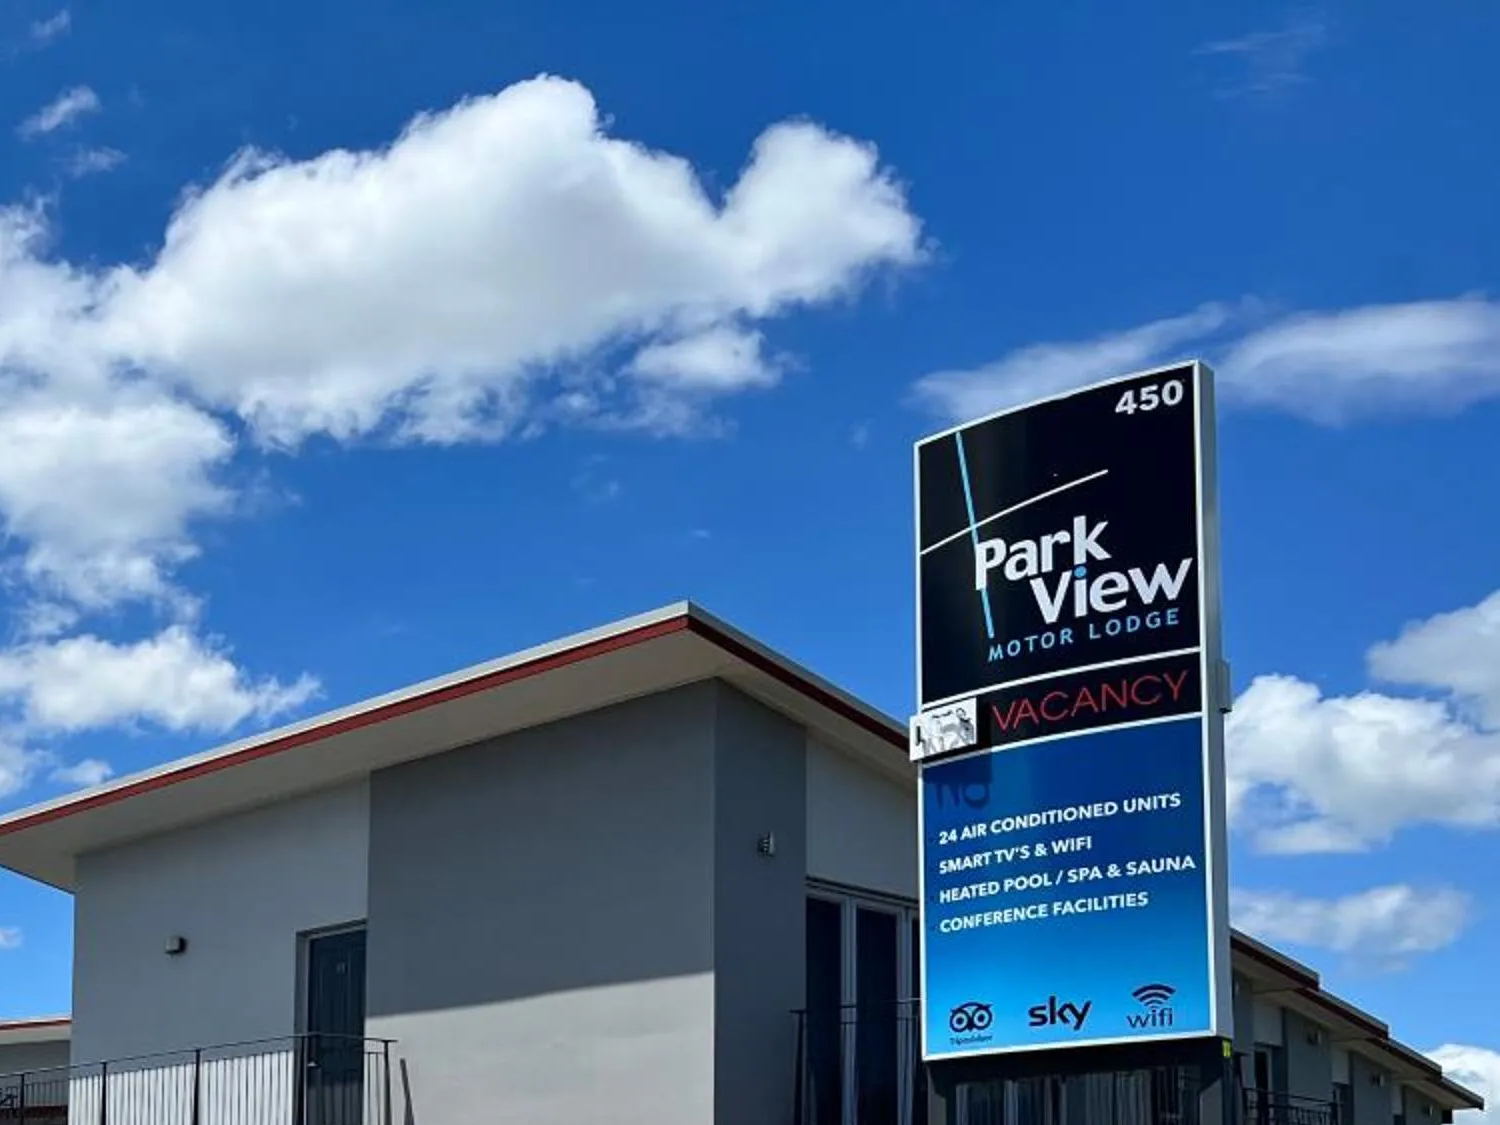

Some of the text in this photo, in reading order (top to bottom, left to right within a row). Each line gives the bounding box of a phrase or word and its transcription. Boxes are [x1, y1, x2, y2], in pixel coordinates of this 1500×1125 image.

[1115, 379, 1184, 414] 450
[975, 515, 1112, 591] Park
[1030, 558, 1193, 624] View
[988, 608, 1180, 662] MOTOR LODGE
[992, 670, 1189, 731] VACANCY
[939, 793, 1181, 845] 24 AIR CONDITIONED UNITS
[939, 836, 1092, 875] SMART TV'S & WIFI
[939, 881, 1000, 904] HEATED
[1003, 873, 1052, 892] POOL
[1067, 866, 1103, 883] SPA
[1107, 863, 1122, 878] &
[1125, 855, 1197, 876] SAUNA
[939, 891, 1149, 933] CONFERENCE FACILITIES
[1028, 995, 1173, 1030] sky wifi
